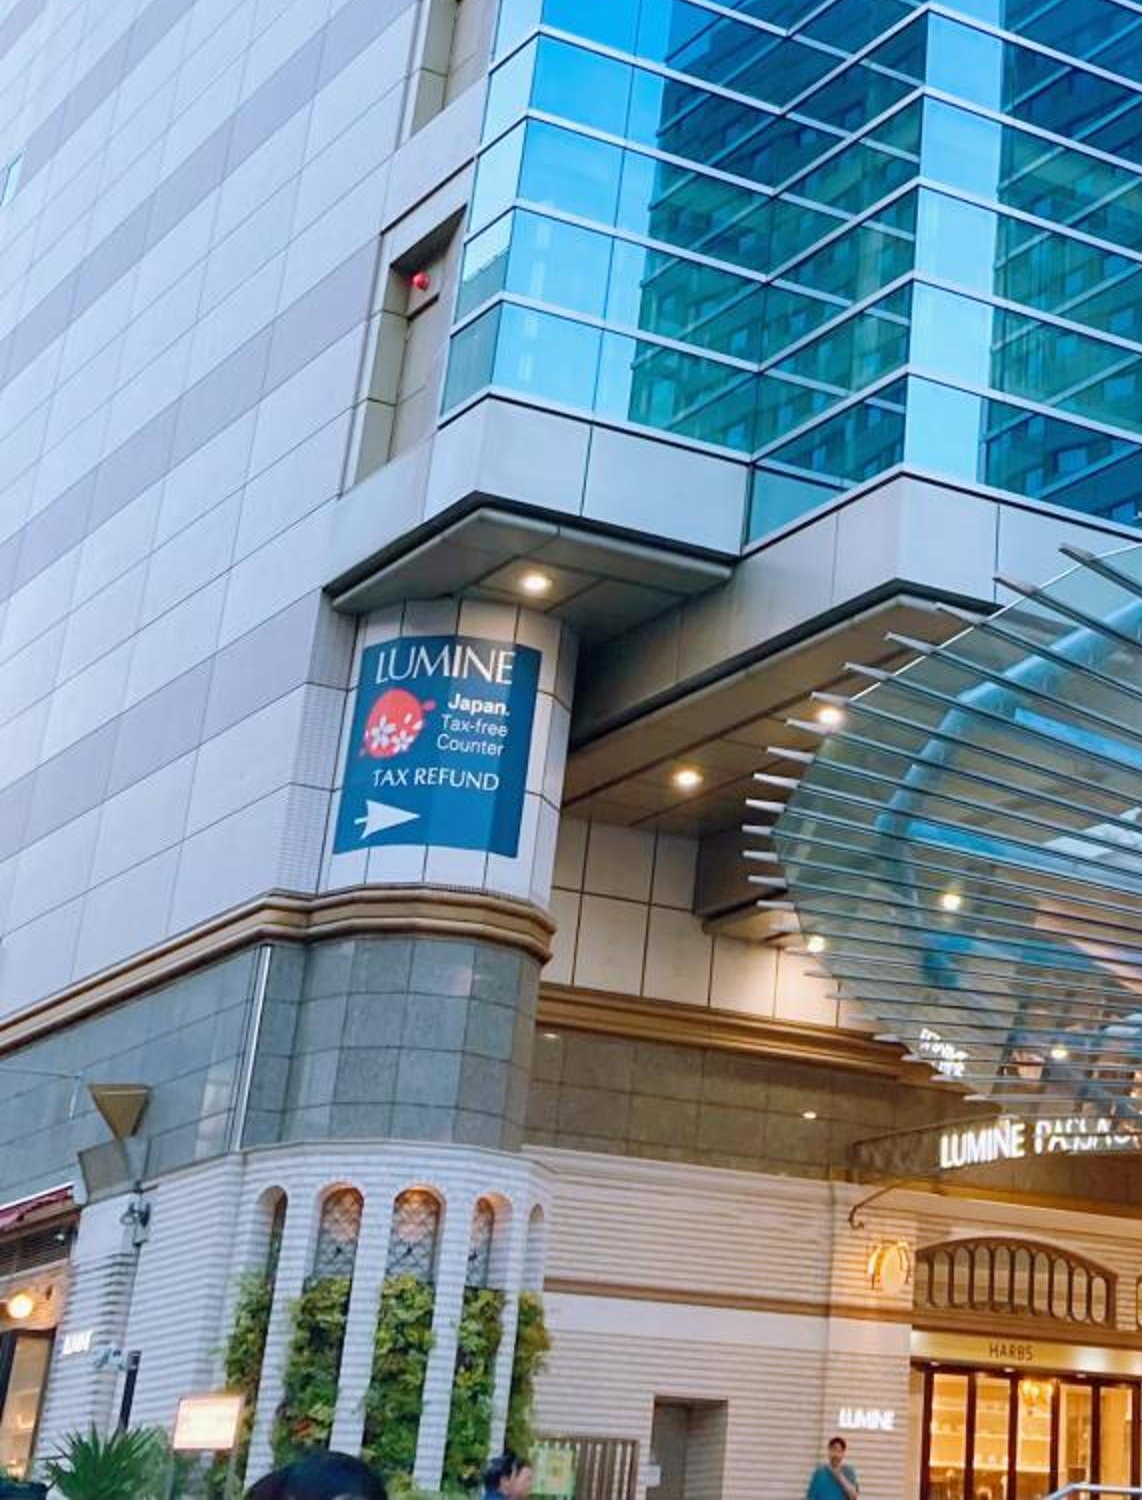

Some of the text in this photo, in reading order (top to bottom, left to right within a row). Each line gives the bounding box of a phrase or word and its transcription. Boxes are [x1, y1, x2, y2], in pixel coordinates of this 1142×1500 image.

[376, 644, 516, 685] LUMINE
[441, 713, 508, 737] Tax-free
[437, 733, 505, 756] Counter
[372, 767, 499, 791] TAX REFUND
[940, 1119, 1025, 1168] LUMINE
[989, 1344, 1034, 1361] HARBS
[839, 1407, 896, 1430] LUMINE
